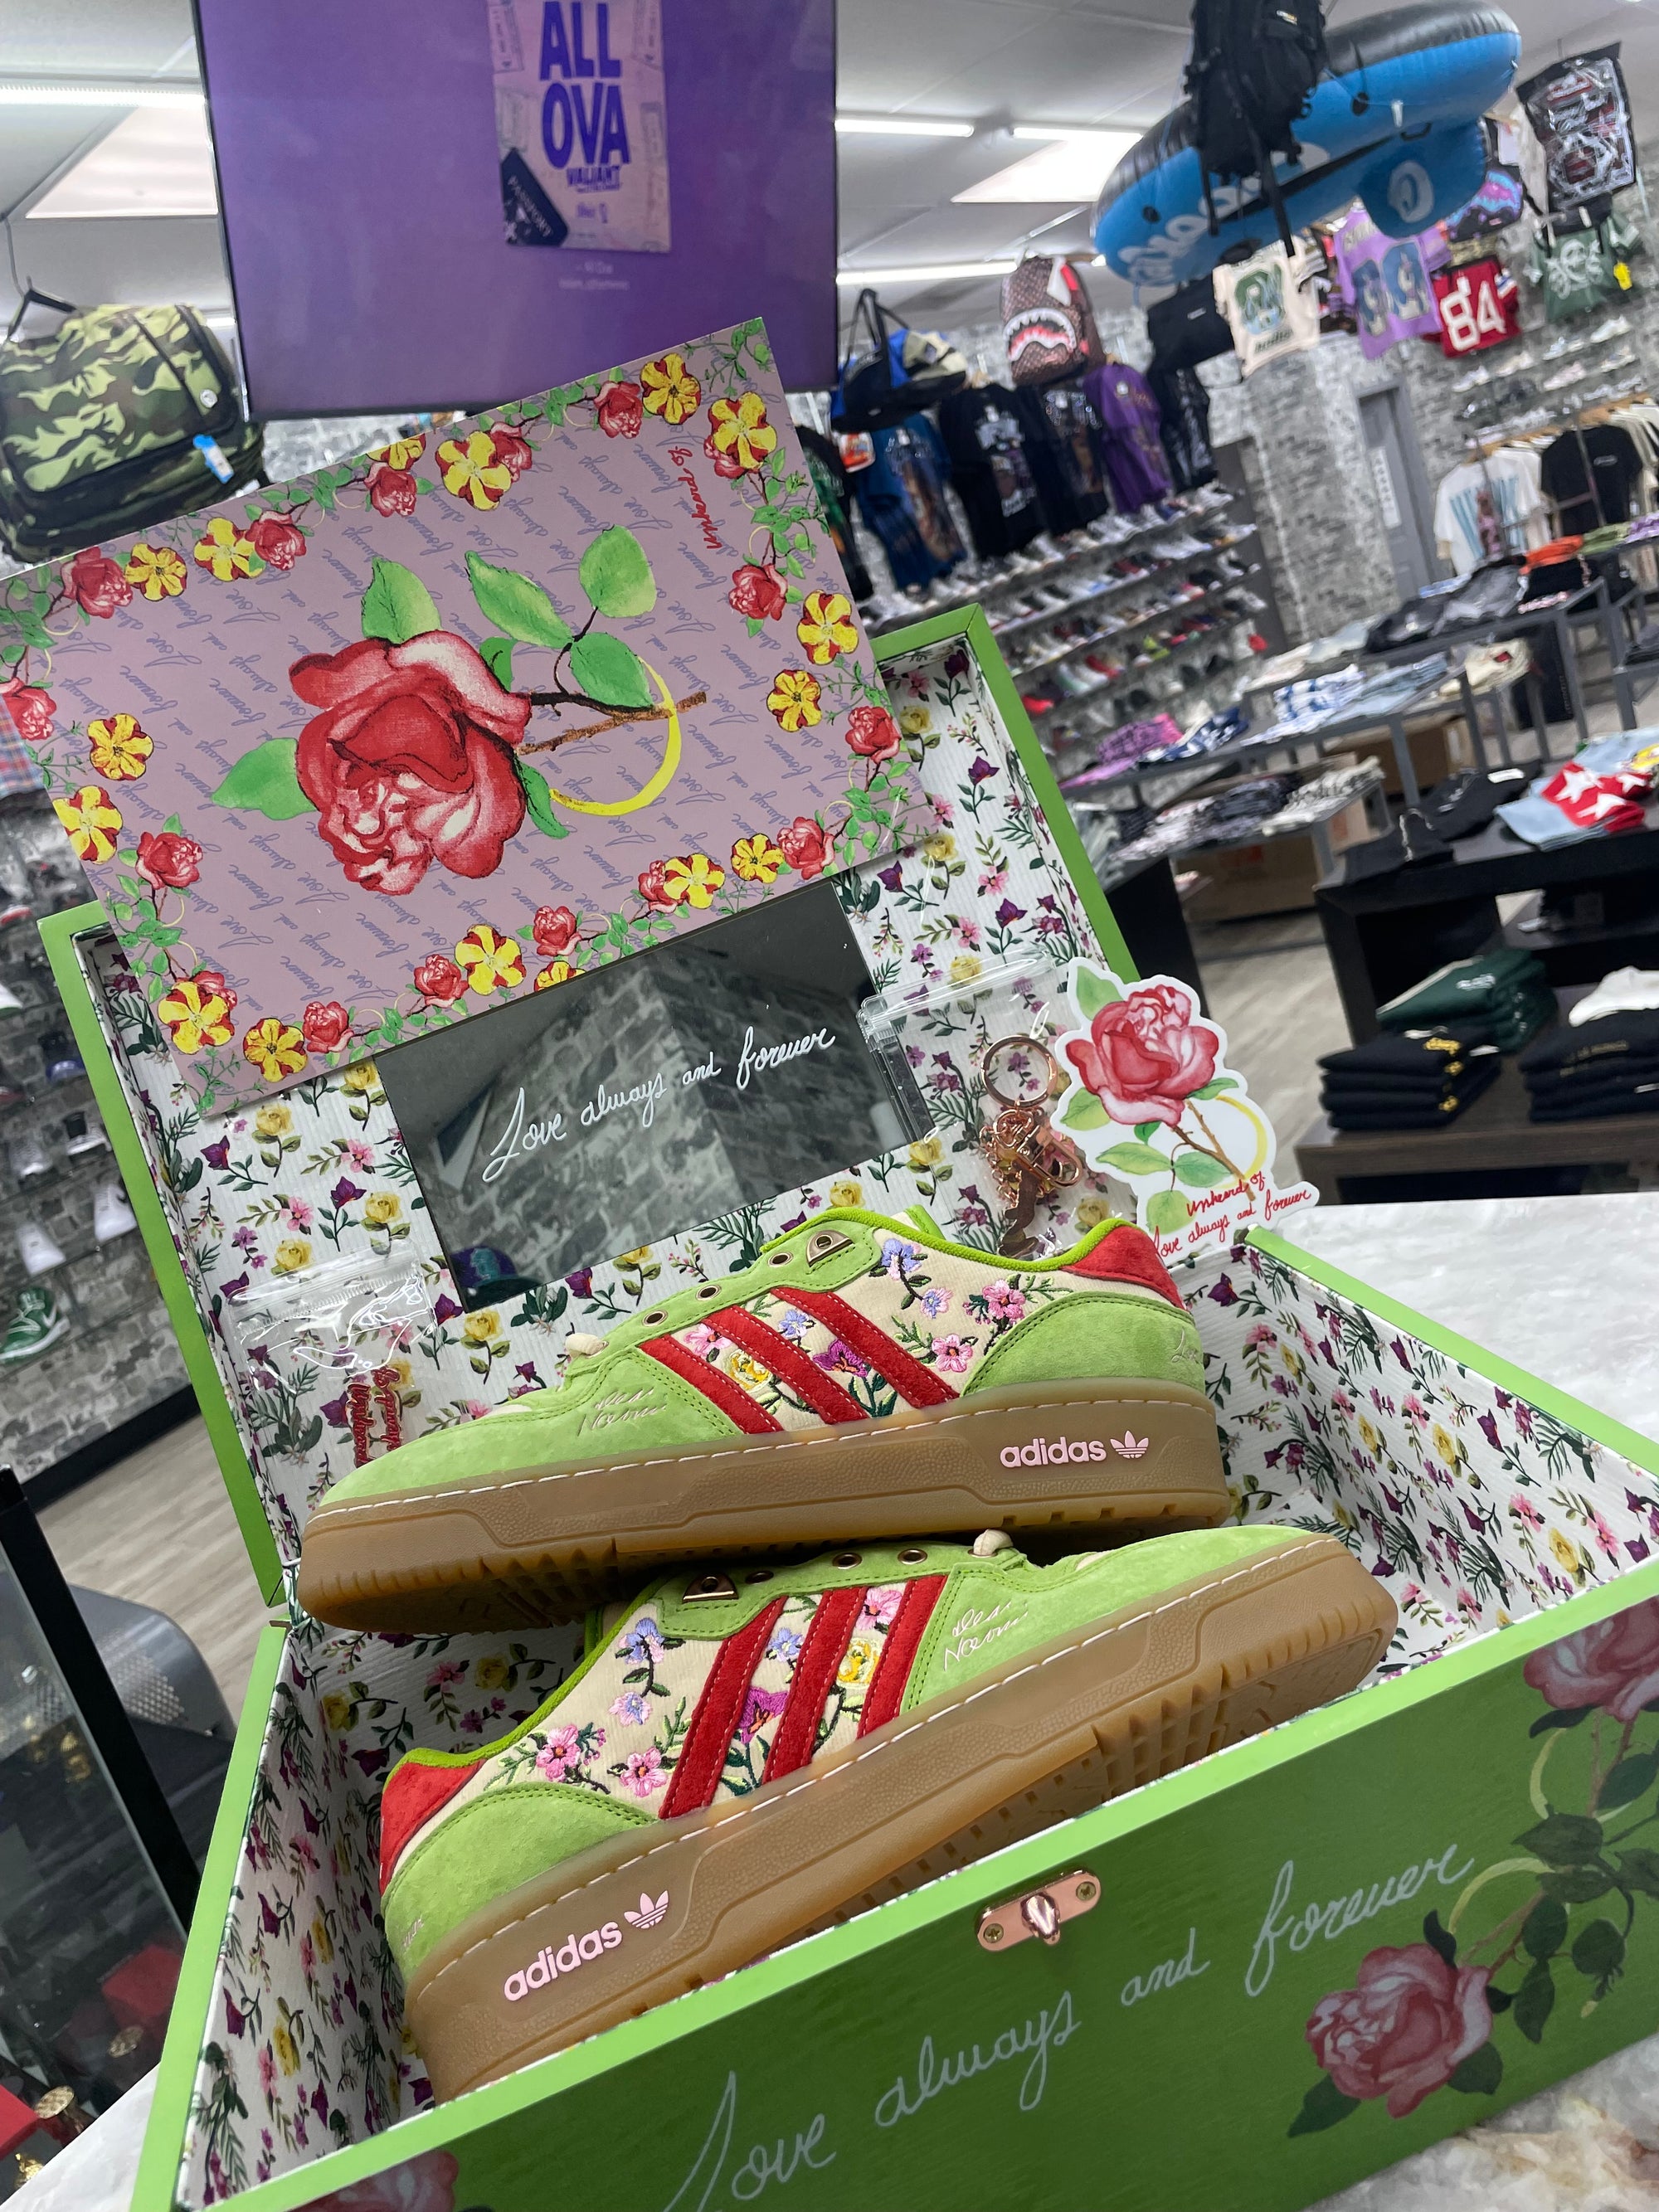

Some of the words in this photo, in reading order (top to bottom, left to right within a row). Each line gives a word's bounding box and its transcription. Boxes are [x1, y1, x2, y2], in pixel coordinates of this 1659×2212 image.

[540, 2, 620, 80] ALL
[542, 83, 631, 169] OVA
[1440, 280, 1506, 352] 84
[482, 1087, 567, 1183] Love
[580, 1073, 667, 1128] always
[682, 1051, 722, 1086] and
[737, 1025, 836, 1091] forever
[1188, 1214, 1230, 1242] always
[1237, 1202, 1256, 1220] and
[1264, 1189, 1311, 1221] forever
[1000, 1437, 1107, 1468] adidas
[504, 1921, 623, 2001] adidas
[664, 2070, 836, 2212] Love
[874, 1991, 1081, 2128] always
[1120, 1928, 1210, 2007] and
[1244, 1843, 1474, 1998] forever
